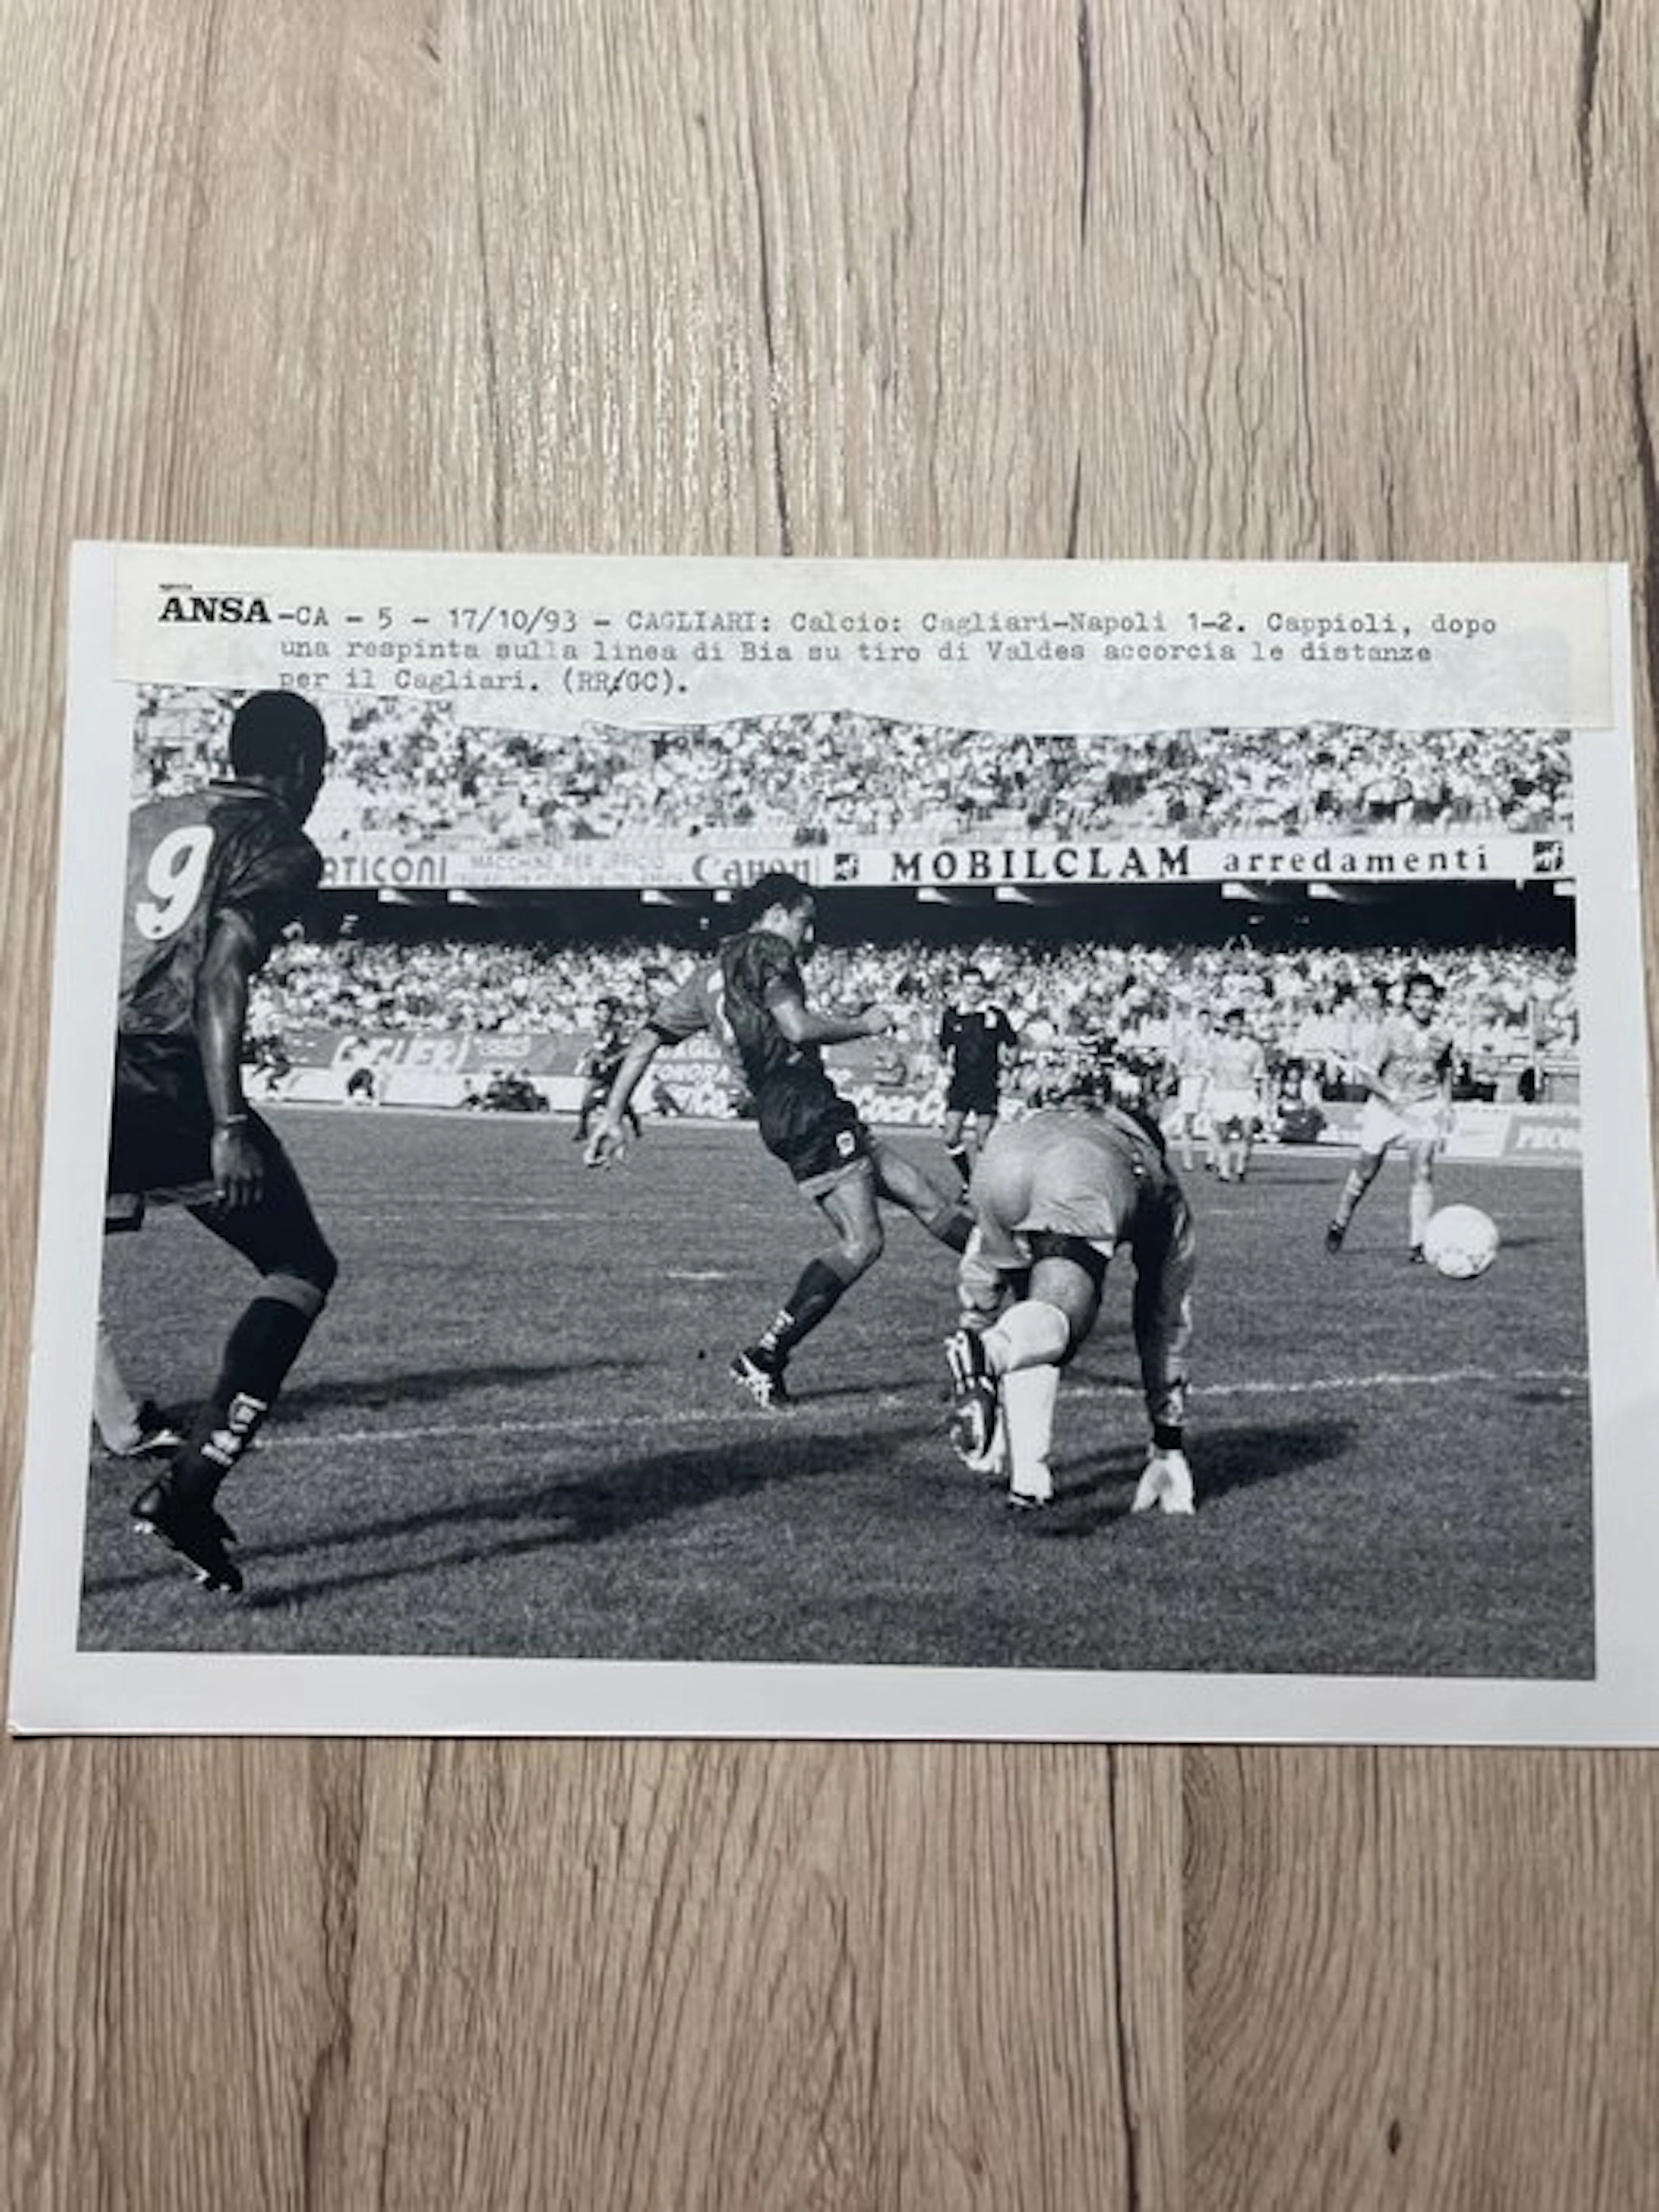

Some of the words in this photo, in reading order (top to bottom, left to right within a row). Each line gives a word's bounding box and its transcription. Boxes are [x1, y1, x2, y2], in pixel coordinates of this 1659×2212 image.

[158, 596, 272, 623] ANSA
[378, 607, 392, 631] 5
[448, 606, 577, 635] 17/10/93
[626, 610, 771, 632] CAGLIARI:
[790, 610, 901, 633] Calcio:
[921, 610, 1166, 637] Cagliari-Napoli
[1188, 611, 1246, 633] 1-2.
[1267, 612, 1411, 639] Cappioli,
[1431, 613, 1497, 639] dopo
[281, 641, 330, 658] una
[346, 639, 480, 663] respinta
[496, 639, 578, 660] sulla
[594, 640, 677, 661] linea
[692, 641, 724, 661] di
[741, 641, 793, 662] Bia
[808, 646, 841, 661] su
[858, 642, 920, 663] tiro
[938, 640, 969, 662] di
[986, 640, 1085, 661] Valdes
[1104, 641, 1236, 661] accorcia
[1252, 641, 1284, 661] le
[1300, 641, 1431, 662] distanze
[279, 673, 329, 691] per
[346, 667, 375, 689] il
[395, 669, 539, 694] Cagliari.
[891, 844, 1189, 881] MOBILCLAM
[1224, 845, 1487, 871] arredamenti
[135, 825, 213, 940] 9
